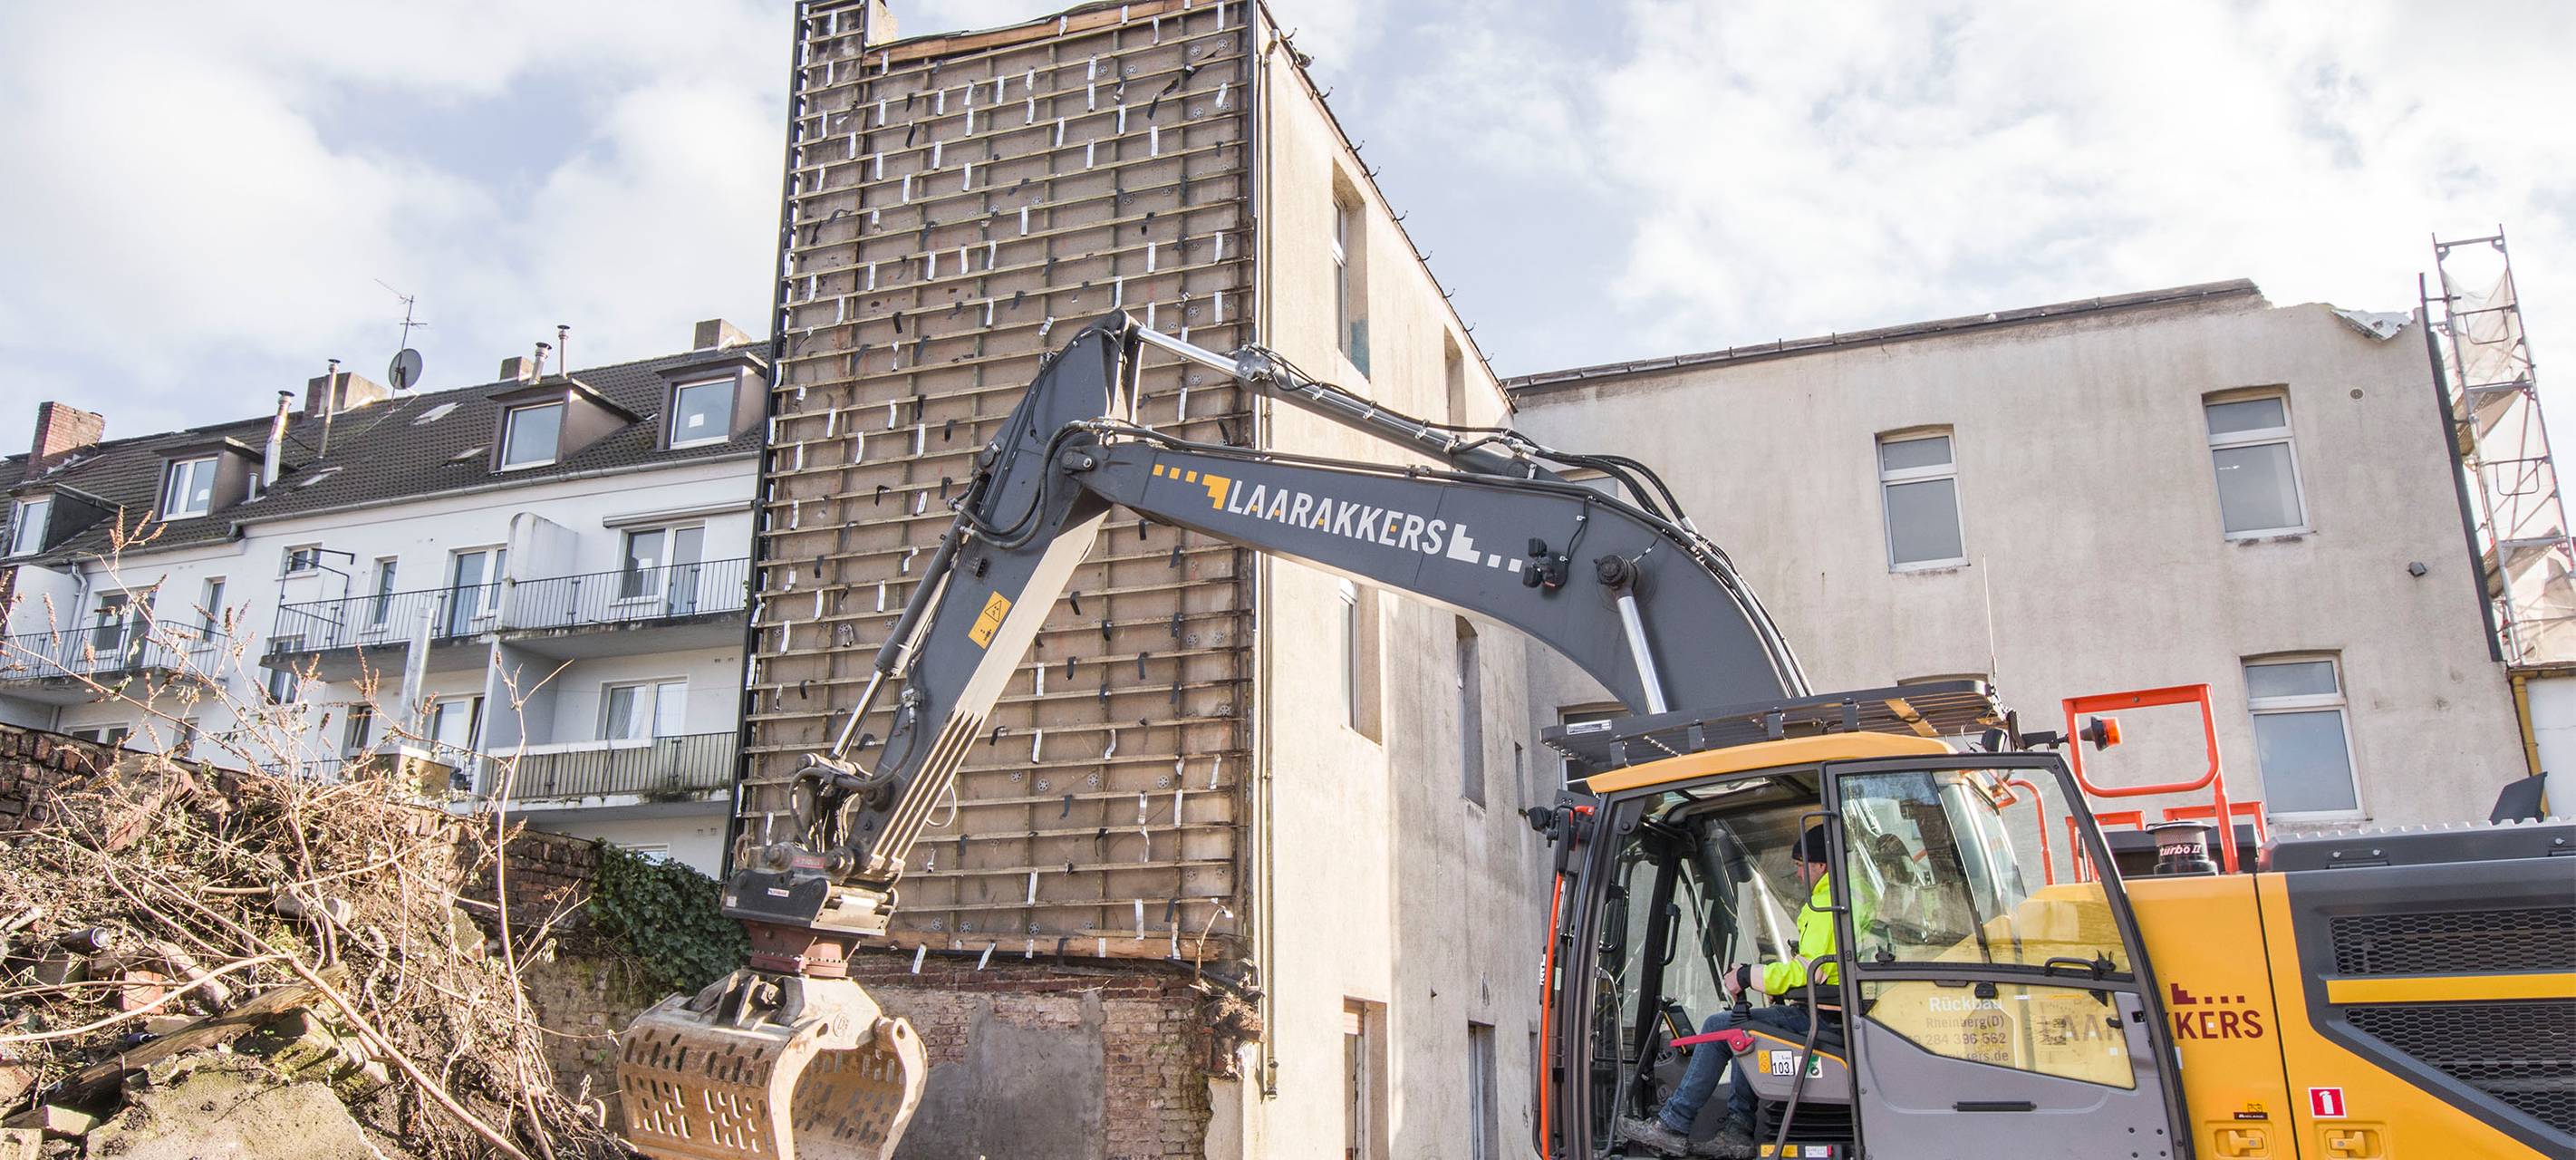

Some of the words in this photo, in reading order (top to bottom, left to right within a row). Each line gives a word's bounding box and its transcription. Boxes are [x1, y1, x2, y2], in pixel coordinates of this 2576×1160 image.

[1228, 480, 1447, 555] LAARAKKERS
[2160, 845, 2190, 856] turbo
[2192, 844, 2202, 854] II
[1928, 997, 2002, 1012] Rückbau
[1925, 1015, 2005, 1030] Rheinberg(D)
[2166, 1010, 2263, 1039] KERS
[1925, 1034, 1948, 1045] 284
[1954, 1033, 1977, 1045] 396
[1982, 1032, 2007, 1044] 562
[1772, 1061, 1790, 1074] 103
